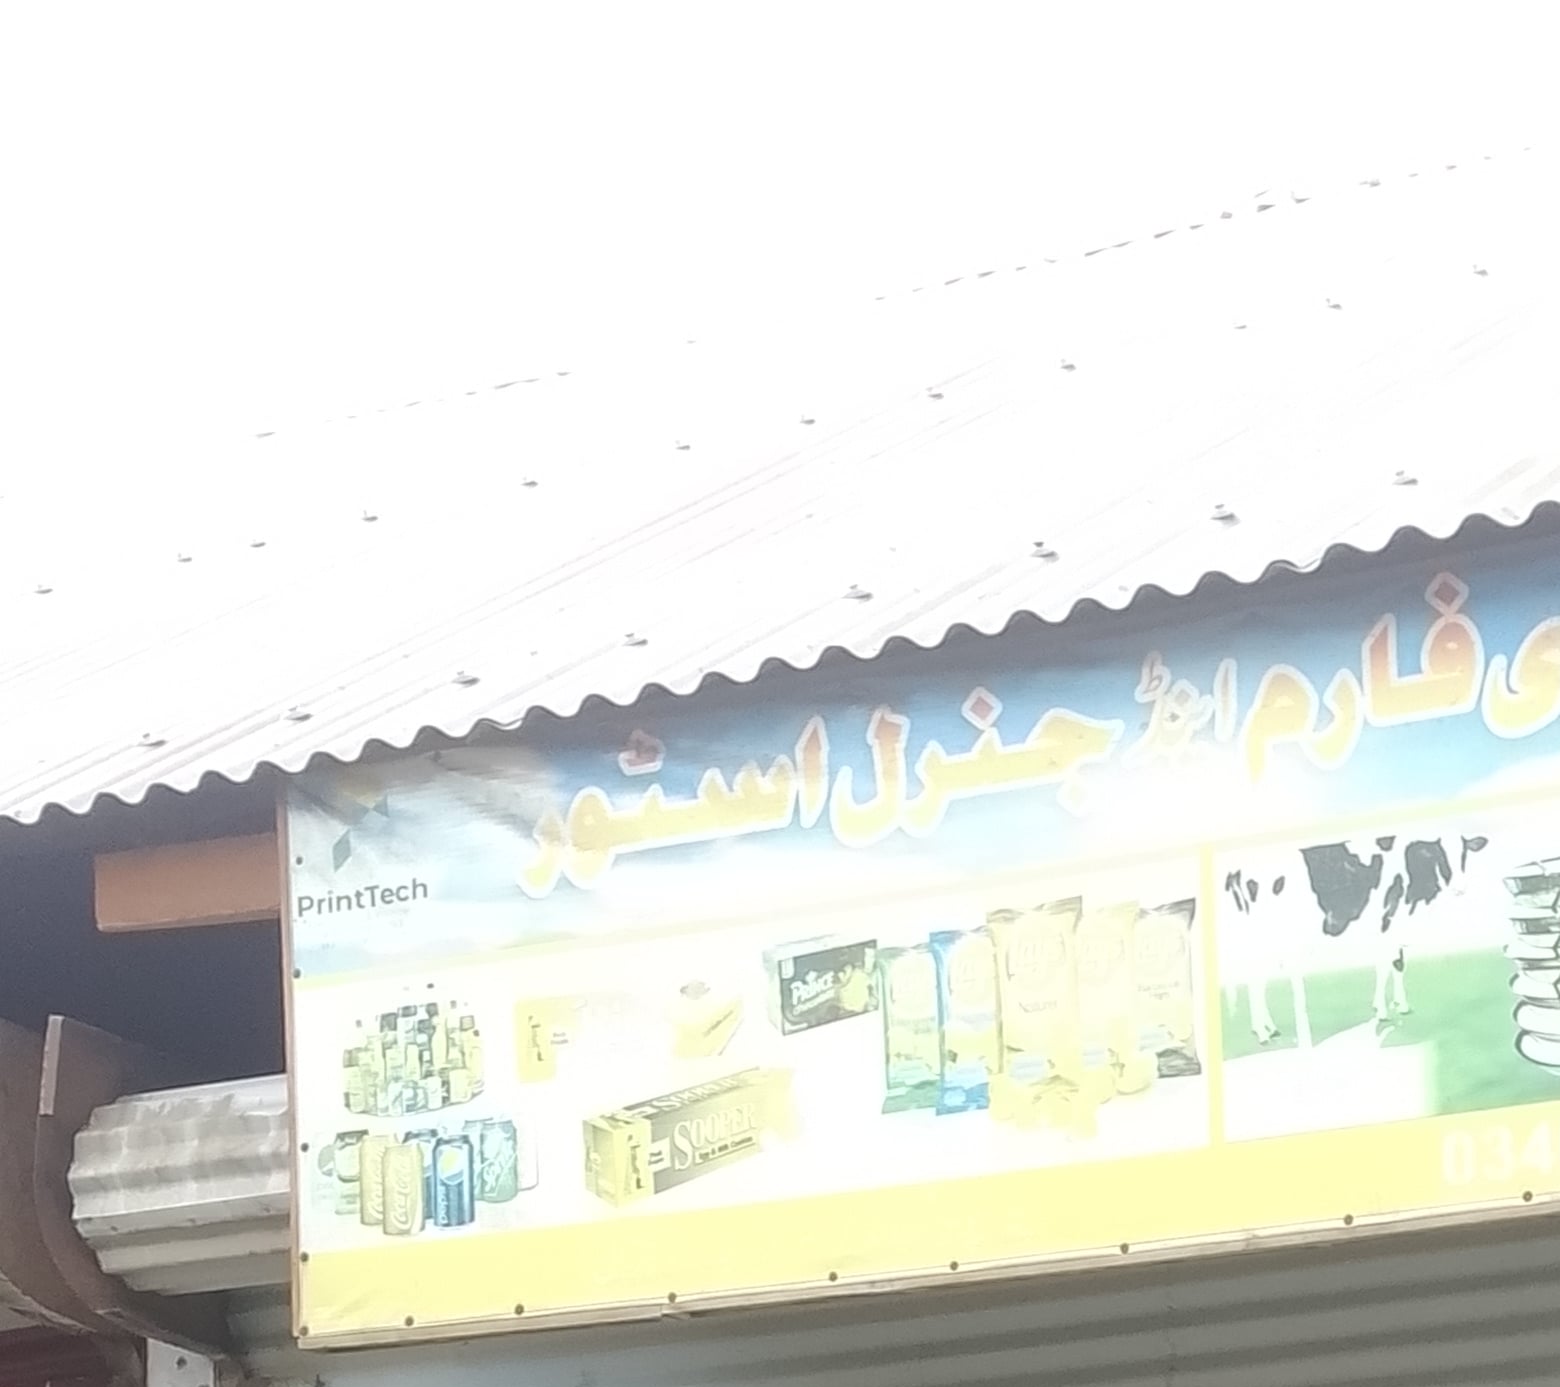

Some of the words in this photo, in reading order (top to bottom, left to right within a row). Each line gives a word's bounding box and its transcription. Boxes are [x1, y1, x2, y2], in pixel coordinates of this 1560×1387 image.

[1240, 573, 1487, 784] فارم
[518, 712, 829, 899] اسٹور
[826, 687, 1126, 848] جنرل
[298, 876, 429, 918] PrintTech
